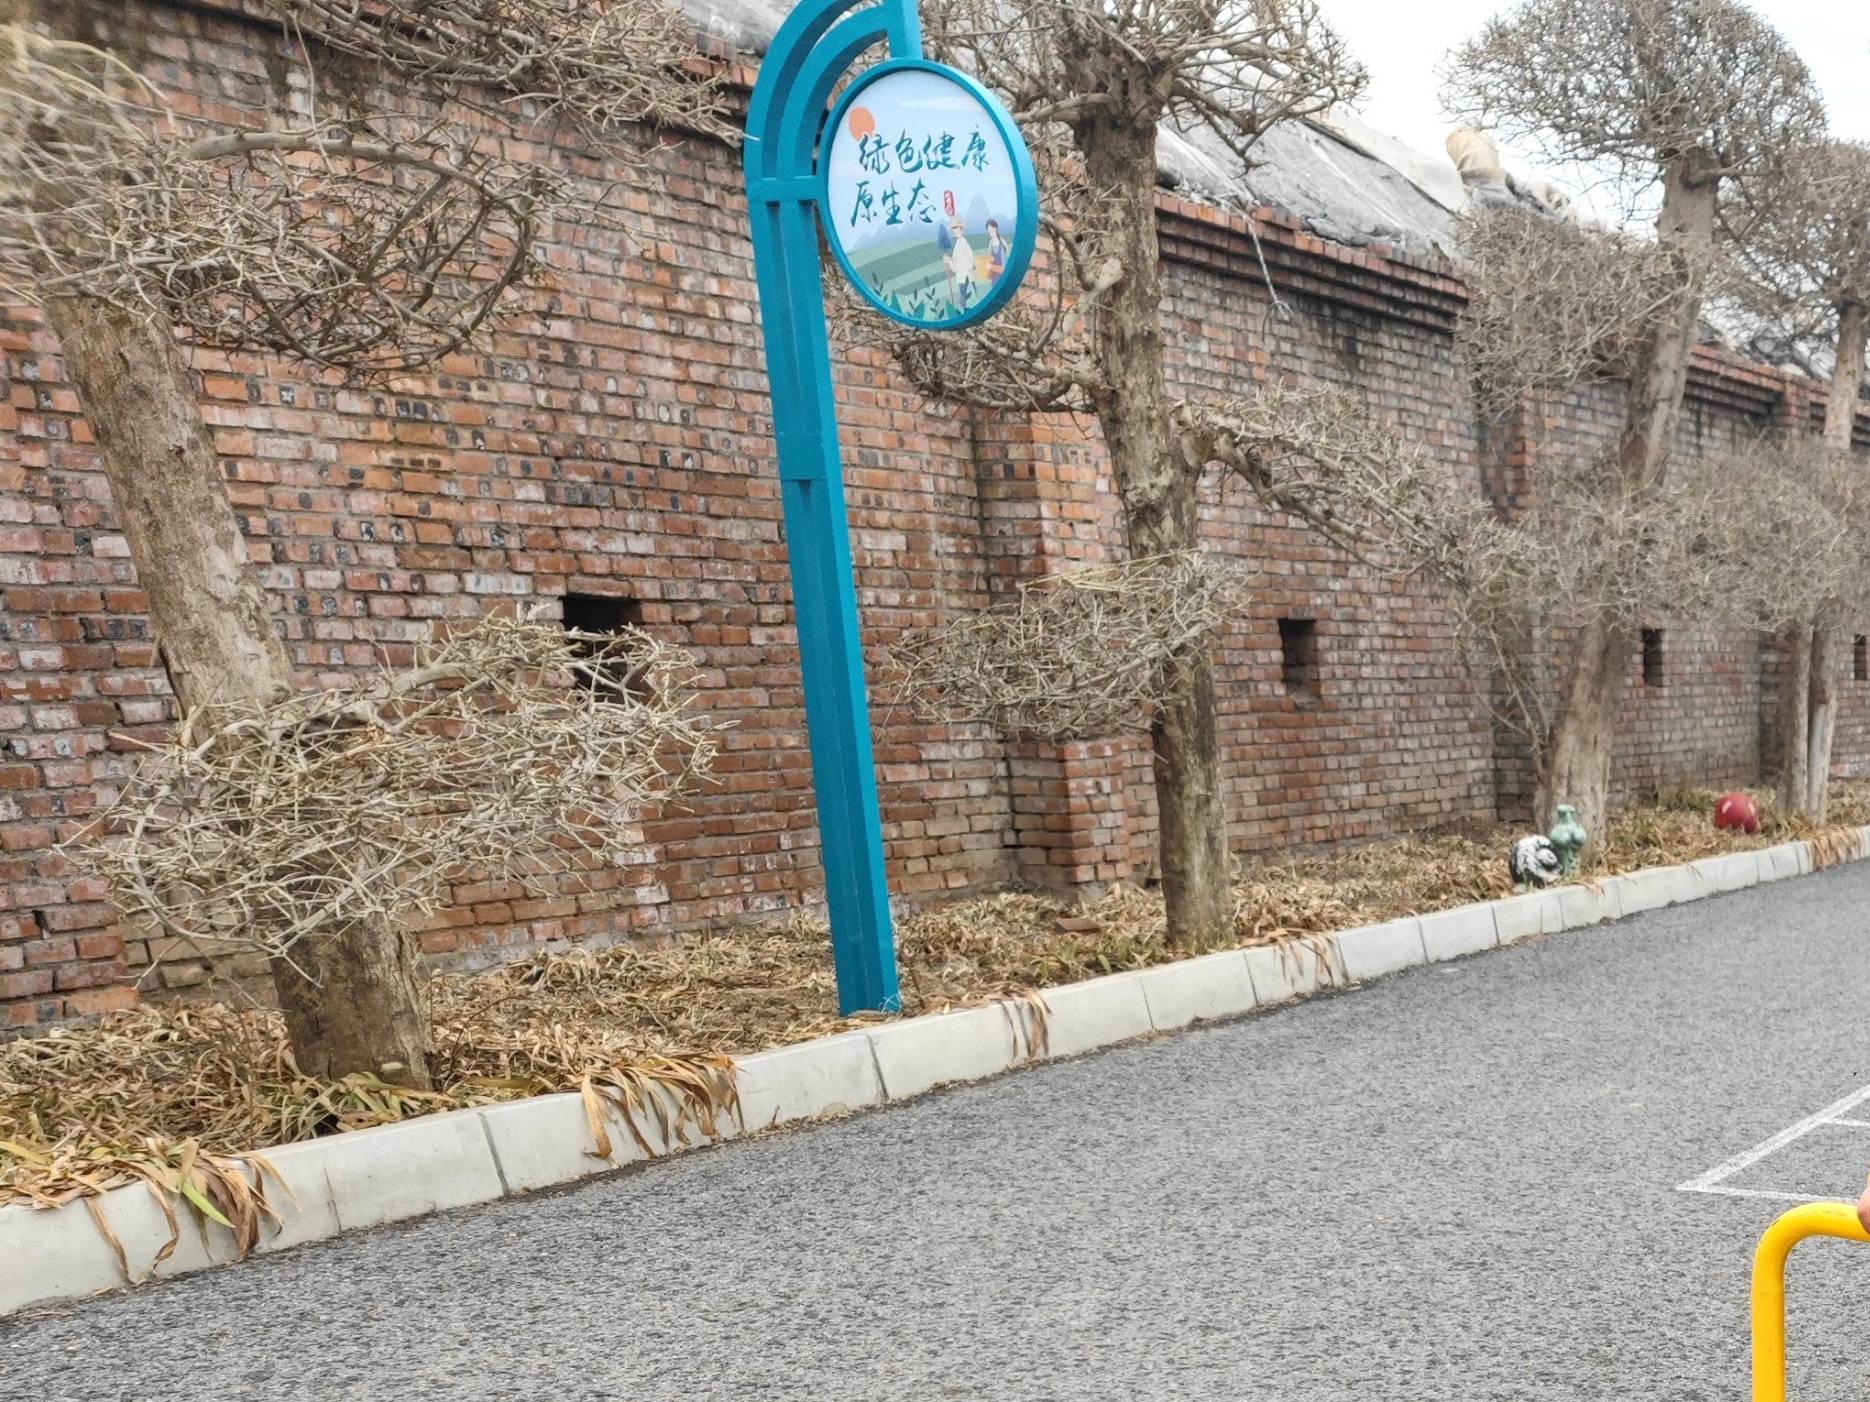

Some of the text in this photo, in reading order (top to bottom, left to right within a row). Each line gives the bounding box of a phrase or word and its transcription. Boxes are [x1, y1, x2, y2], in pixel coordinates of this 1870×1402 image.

[858, 125, 990, 175] 绿色健康
[850, 177, 937, 228] 原生态
